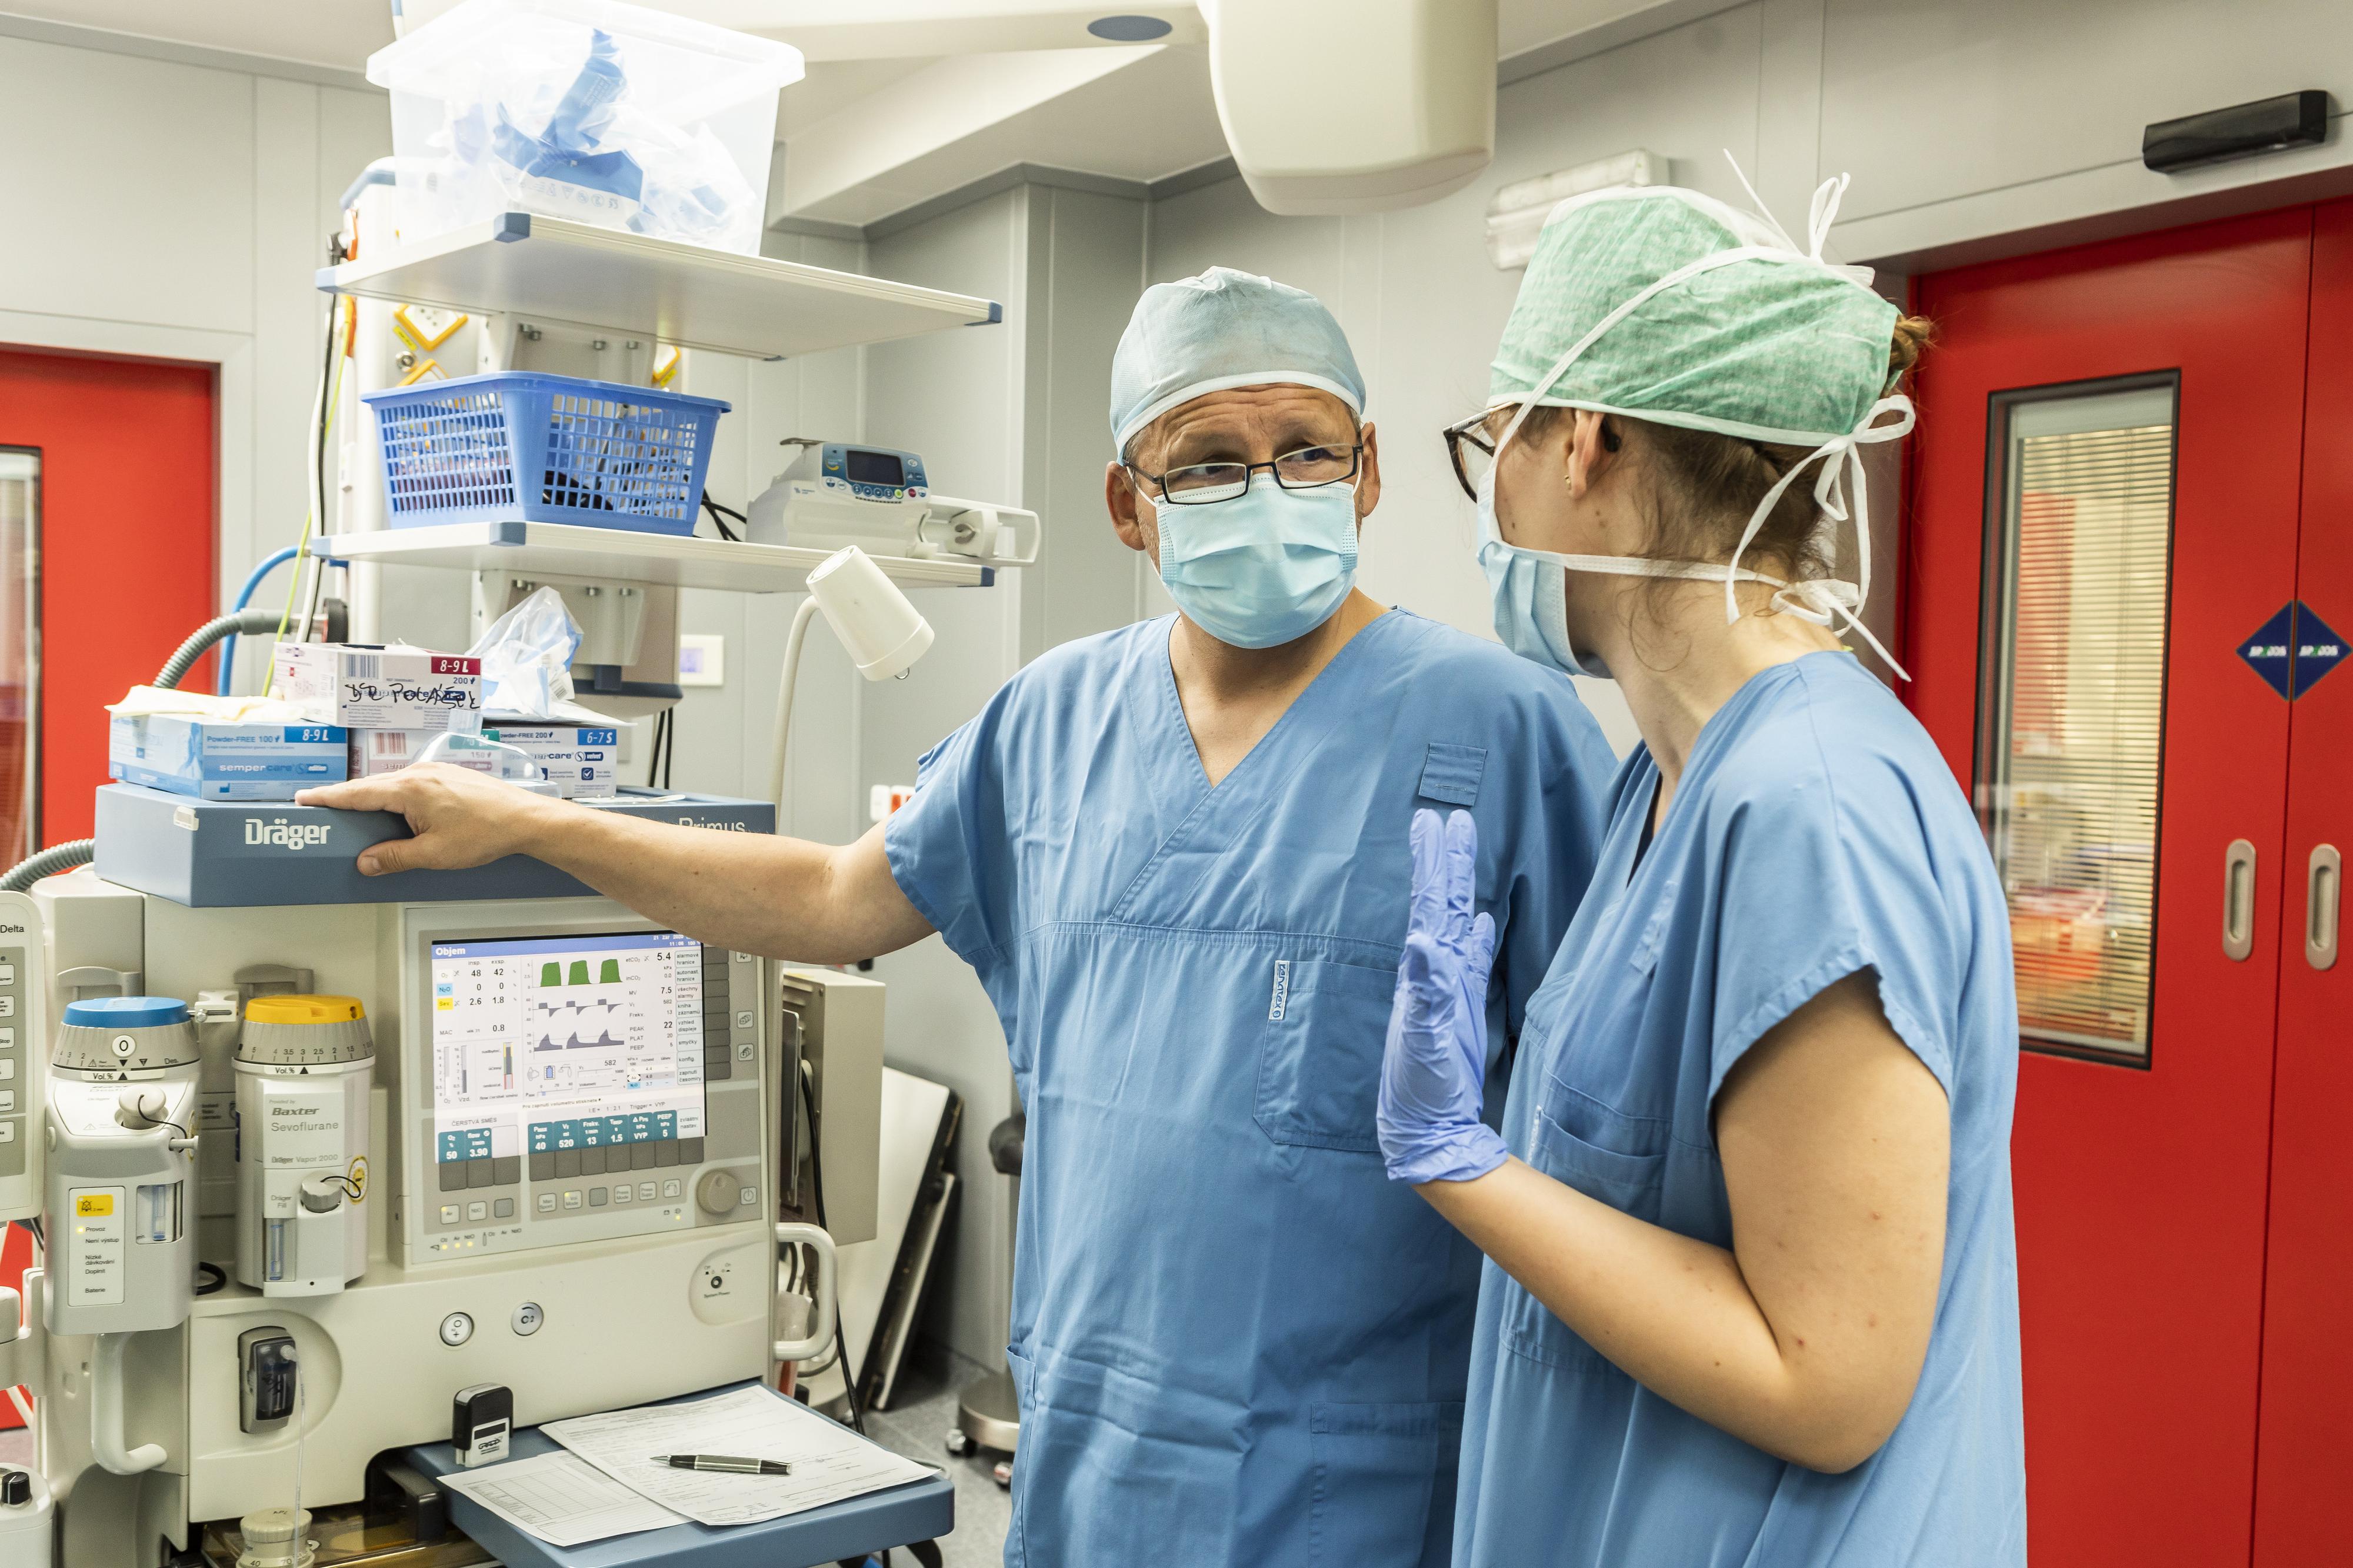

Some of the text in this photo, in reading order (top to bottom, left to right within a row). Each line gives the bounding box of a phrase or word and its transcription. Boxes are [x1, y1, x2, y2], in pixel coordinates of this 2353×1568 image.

[440, 659, 469, 673] 8-9 L
[302, 729, 329, 741] 8-9 L
[586, 732, 613, 744] 6-7 S
[219, 765, 292, 773] sempercare
[245, 818, 331, 850] Dräger
[0, 925, 25, 933] Delta
[435, 948, 466, 956] Objem
[657, 952, 671, 960] 5.4
[470, 997, 482, 1006] 2.6
[493, 1024, 505, 1032] 0.8
[272, 1107, 320, 1116] Baxter
[271, 1122, 339, 1132] Sevoflurane
[662, 1129, 668, 1137] 5
[587, 1137, 597, 1145] 13
[611, 1134, 623, 1143] 1.5
[535, 1142, 546, 1150] 40
[559, 1139, 574, 1148] 520
[446, 1150, 458, 1160] 50
[469, 1148, 488, 1157] 3.90
